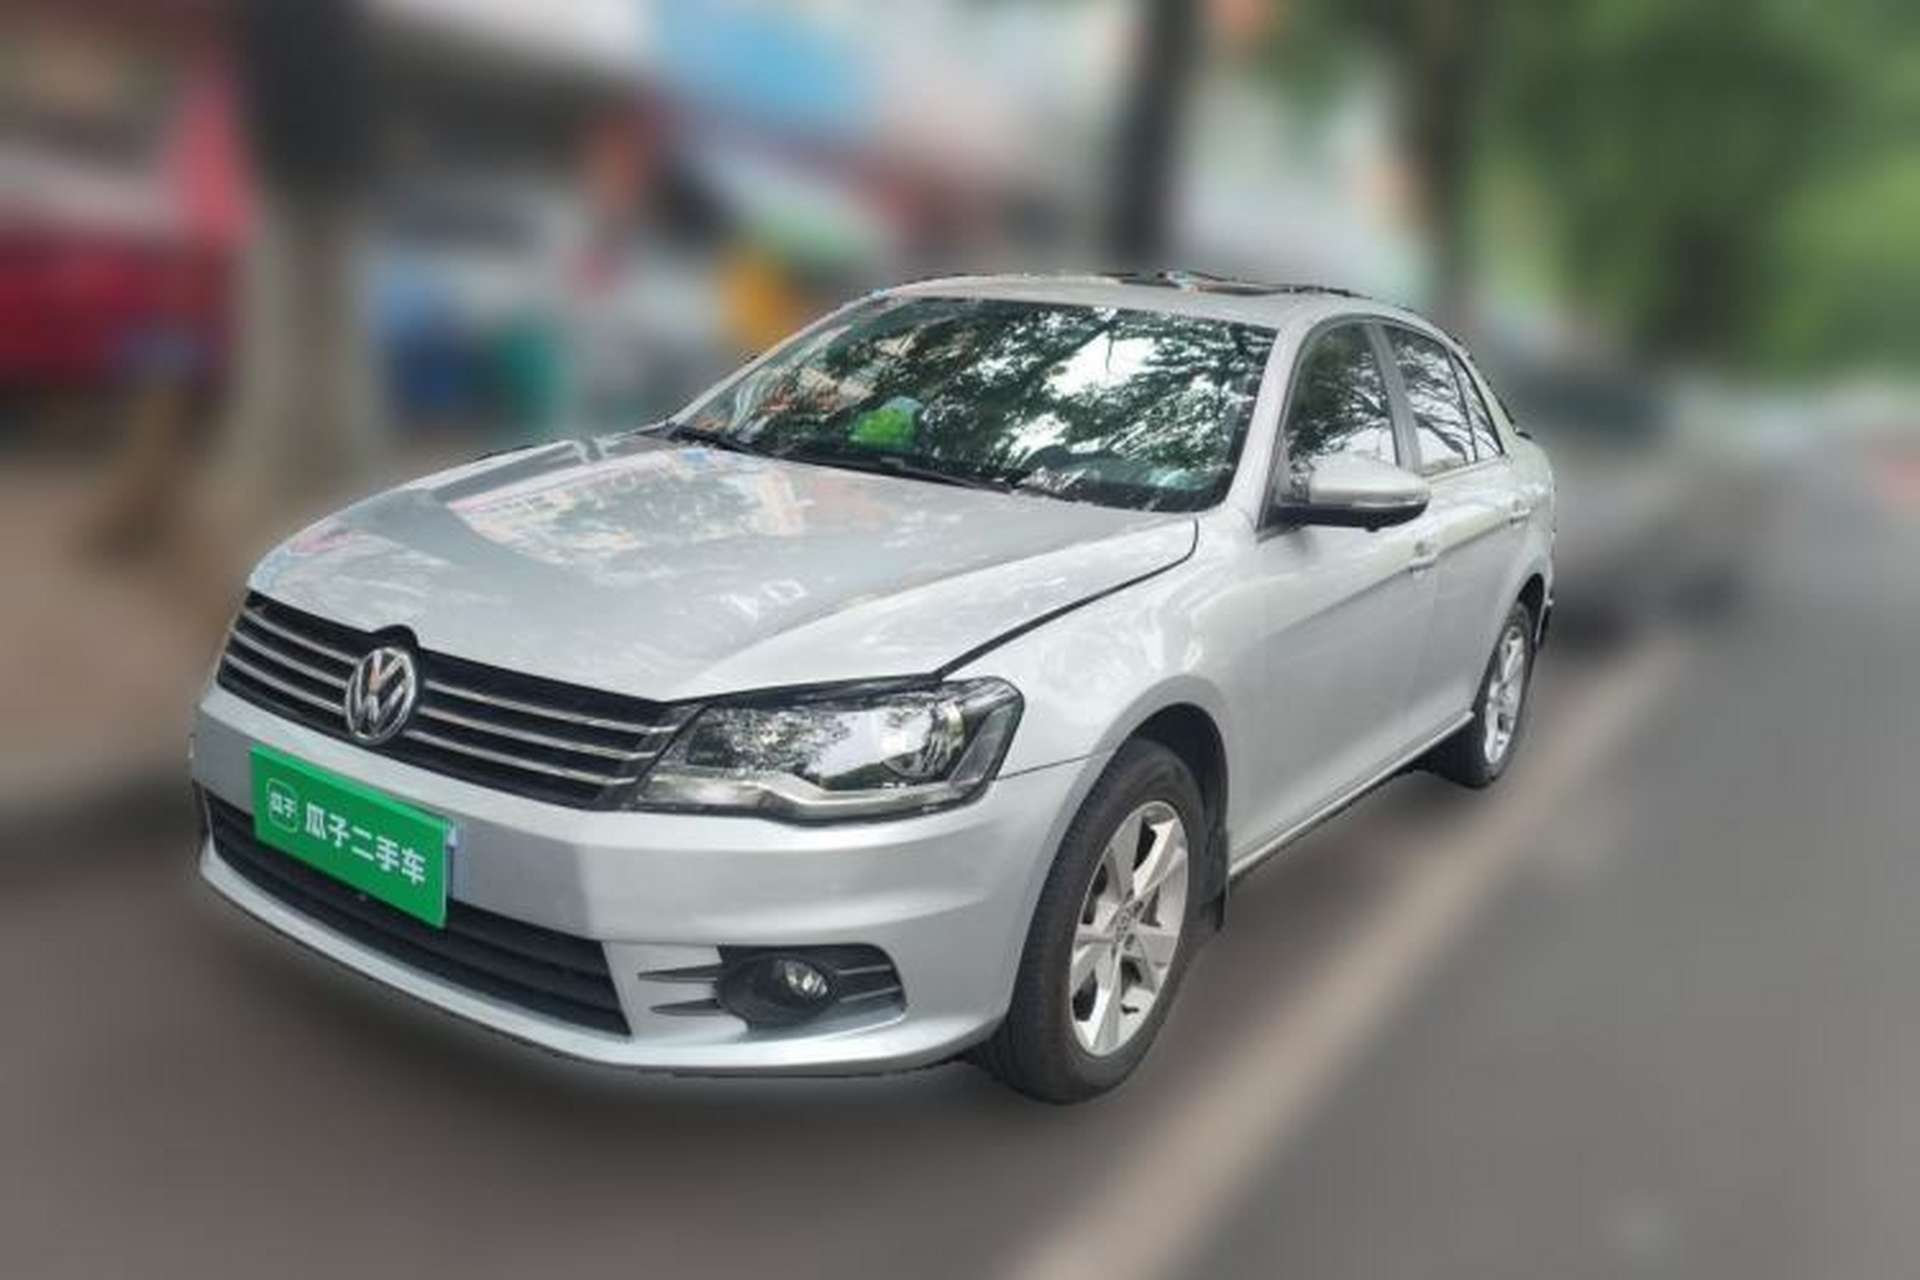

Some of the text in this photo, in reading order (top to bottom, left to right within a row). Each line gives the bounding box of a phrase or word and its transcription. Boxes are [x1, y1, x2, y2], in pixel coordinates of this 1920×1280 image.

[305, 801, 426, 885] 瓜子二手车
